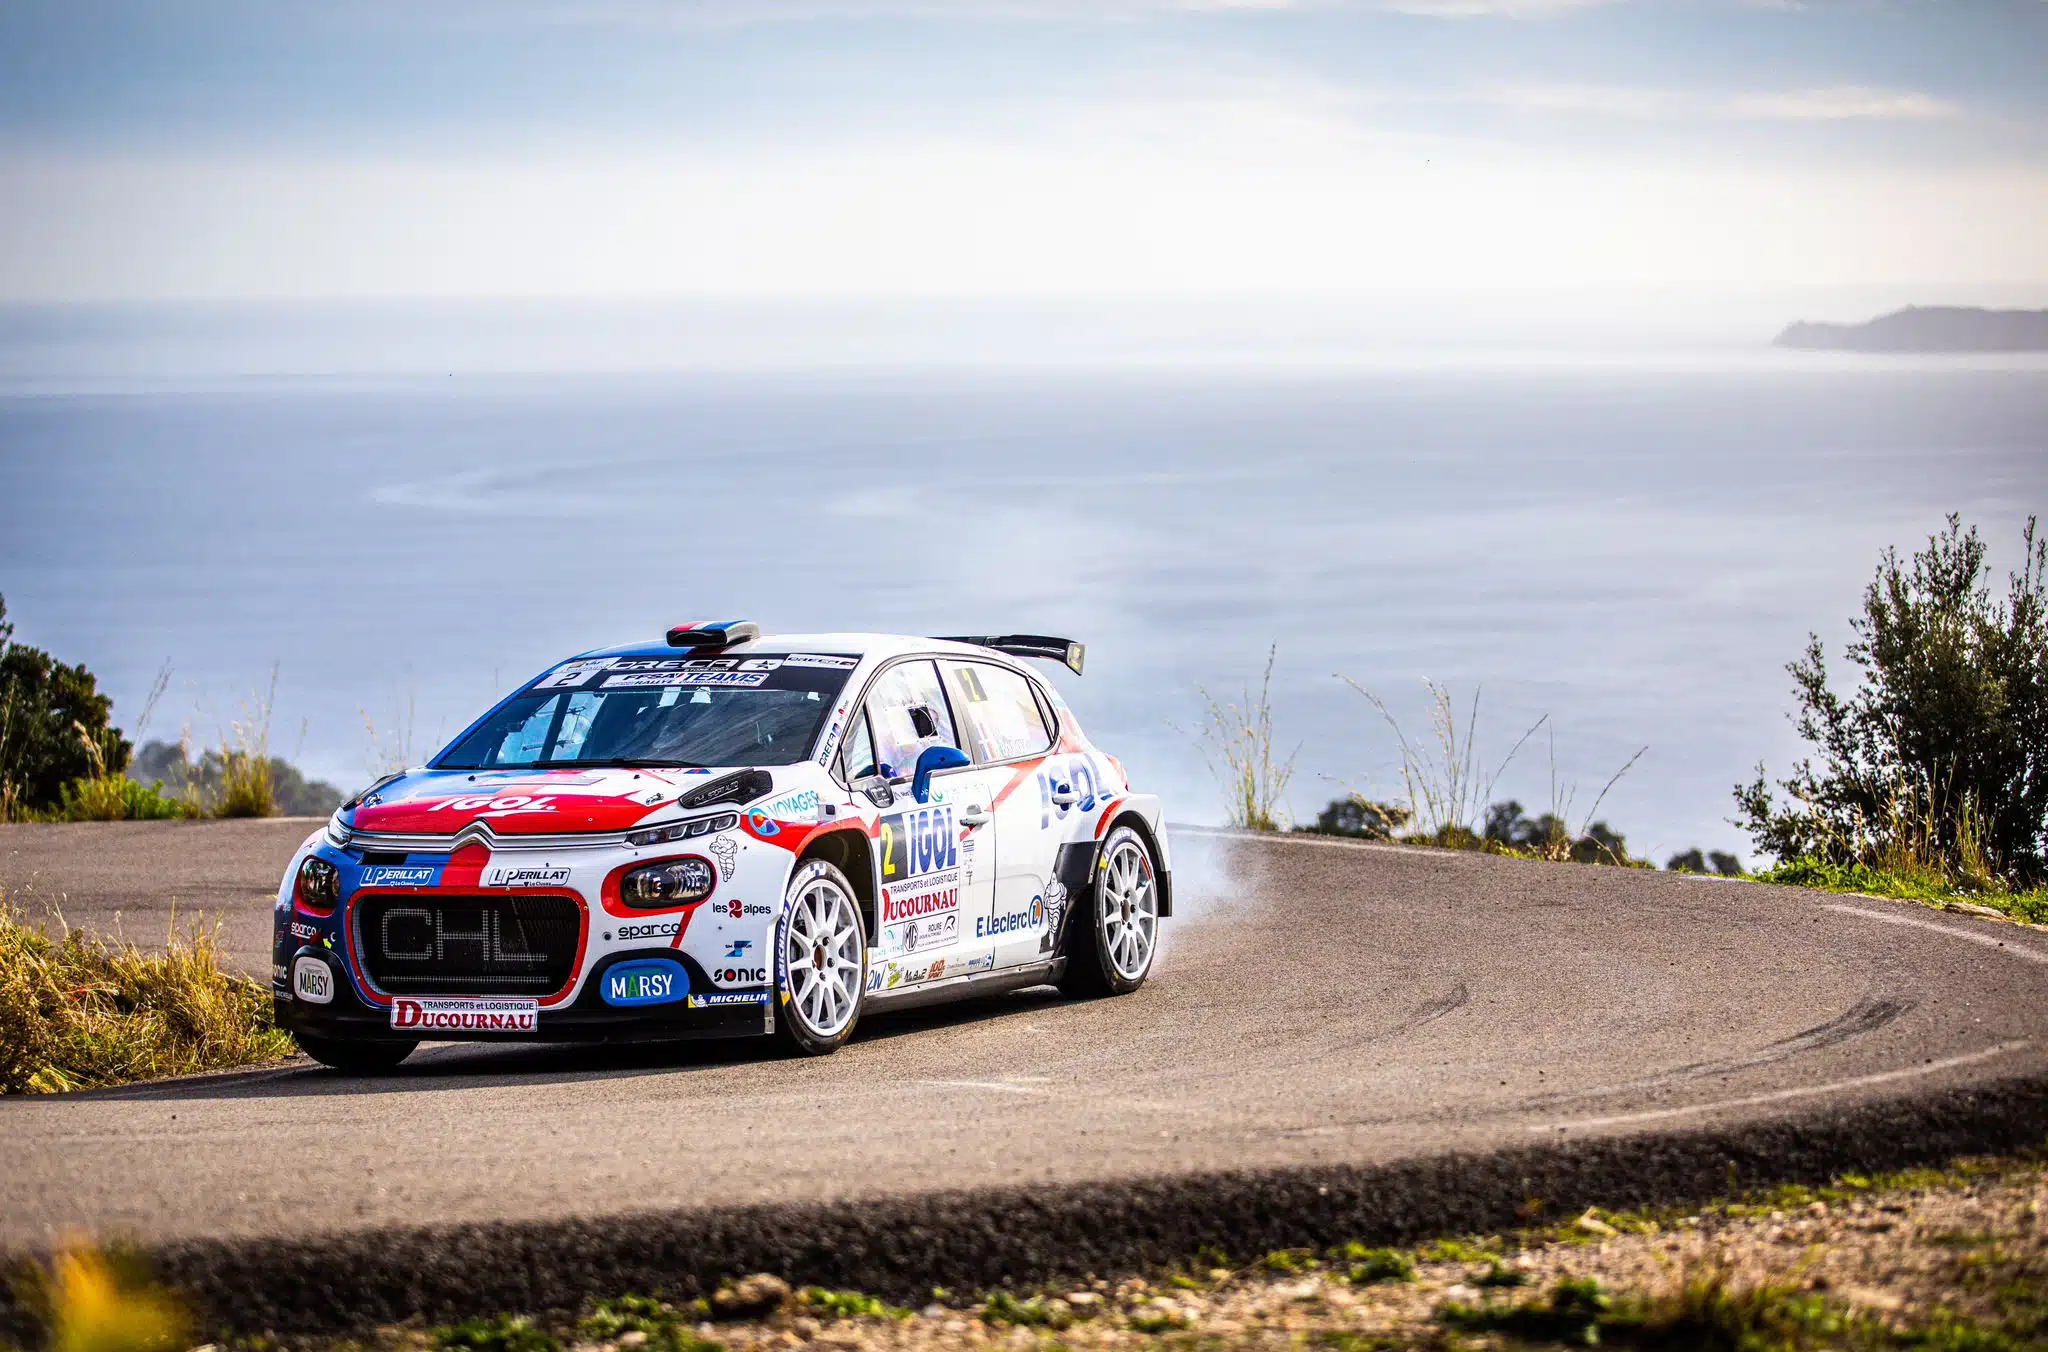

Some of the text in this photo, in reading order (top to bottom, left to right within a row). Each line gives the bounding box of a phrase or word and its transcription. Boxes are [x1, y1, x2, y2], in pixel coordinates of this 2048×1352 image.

[552, 672, 582, 687] 2
[684, 673, 764, 682] TEAMS
[768, 790, 820, 817] VOYAGES
[880, 822, 896, 876] 2
[909, 807, 957, 875] IGOL
[890, 873, 958, 894] TRANSPORTS et LOGISTIQUE
[712, 899, 772, 919] les 2 alpes
[291, 922, 317, 936] sparco
[382, 909, 548, 961] CHL
[618, 923, 682, 940] sparco
[976, 911, 1028, 938] E.Leclerc
[777, 904, 790, 977] MICHELIN
[299, 971, 329, 997] MARSY
[611, 974, 673, 999] MARSY
[423, 1001, 534, 1010] TRANSPORTS et LOGISTIQUE
[709, 993, 768, 1004] MICHELIN
[394, 1000, 534, 1030] DUCOURNAU
